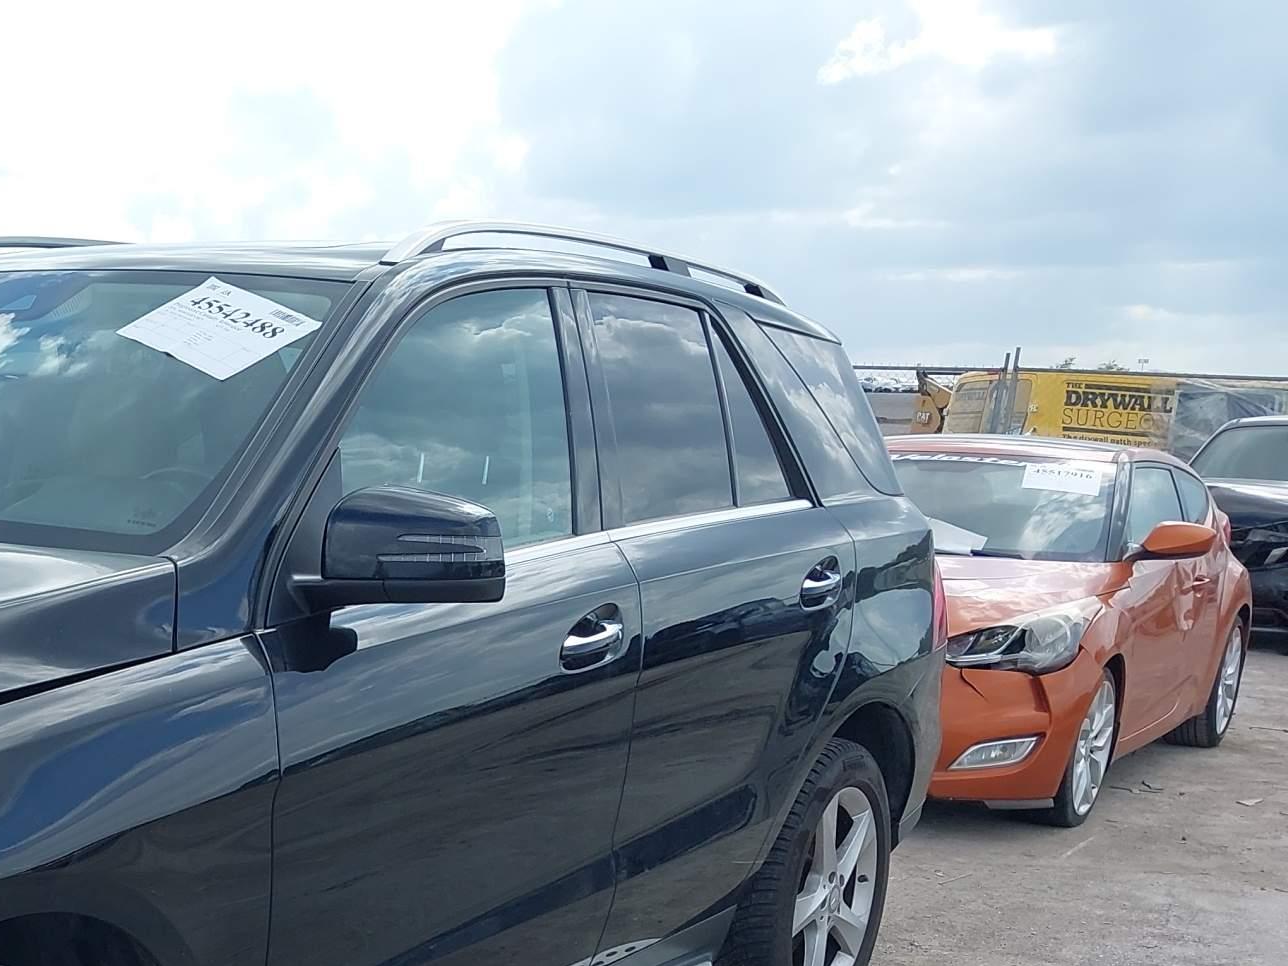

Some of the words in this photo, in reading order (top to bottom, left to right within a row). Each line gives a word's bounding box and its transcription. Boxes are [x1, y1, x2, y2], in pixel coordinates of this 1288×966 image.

[191, 296, 285, 339] 45542488
[1064, 390, 1172, 413] DRYWALL
[916, 411, 930, 424] CAT
[1062, 408, 1168, 431] SURGEO
